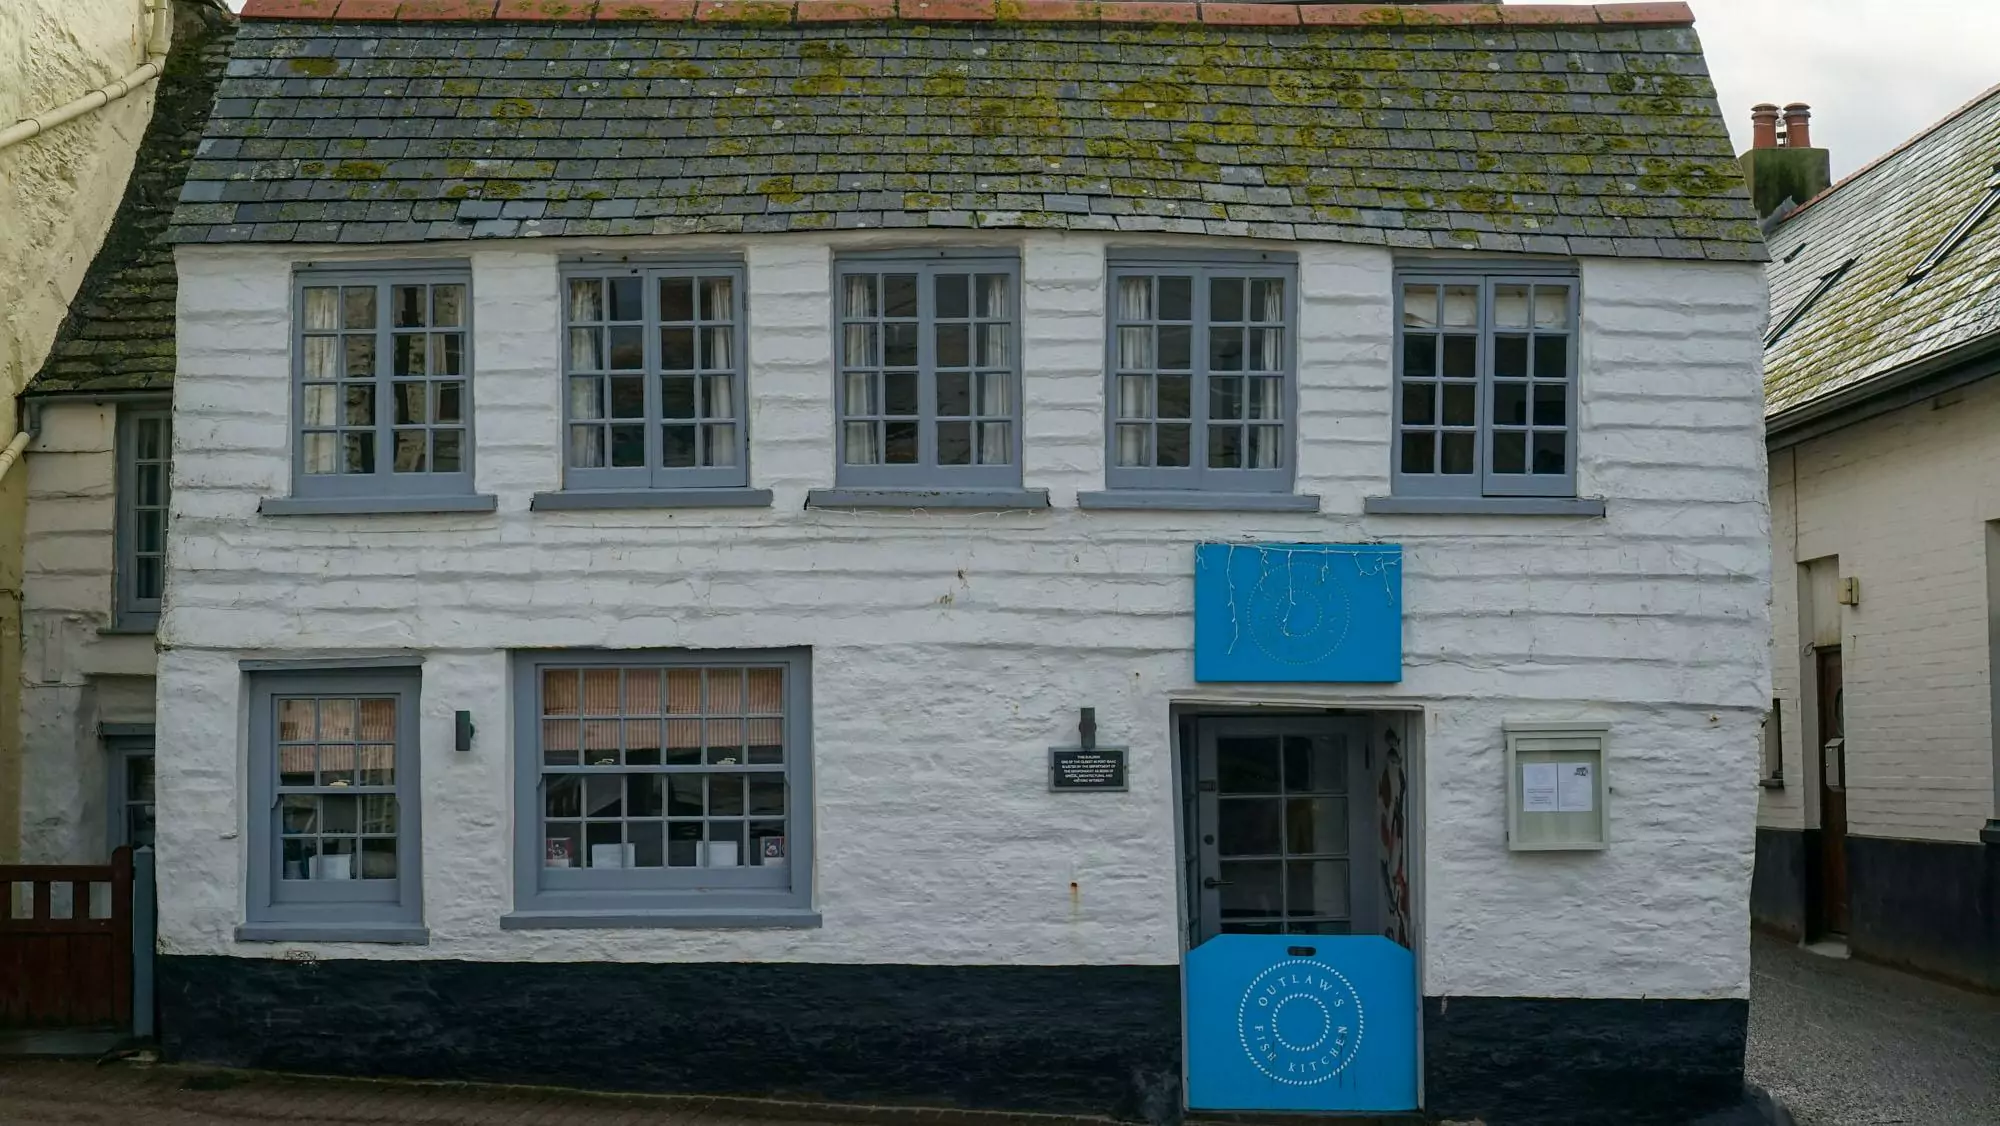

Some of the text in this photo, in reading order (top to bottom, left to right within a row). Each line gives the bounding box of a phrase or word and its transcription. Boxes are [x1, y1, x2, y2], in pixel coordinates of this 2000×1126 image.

[1258, 974, 1345, 1008] OUTLAW'S
[1254, 1025, 1348, 1073] FISH KITCHEN
